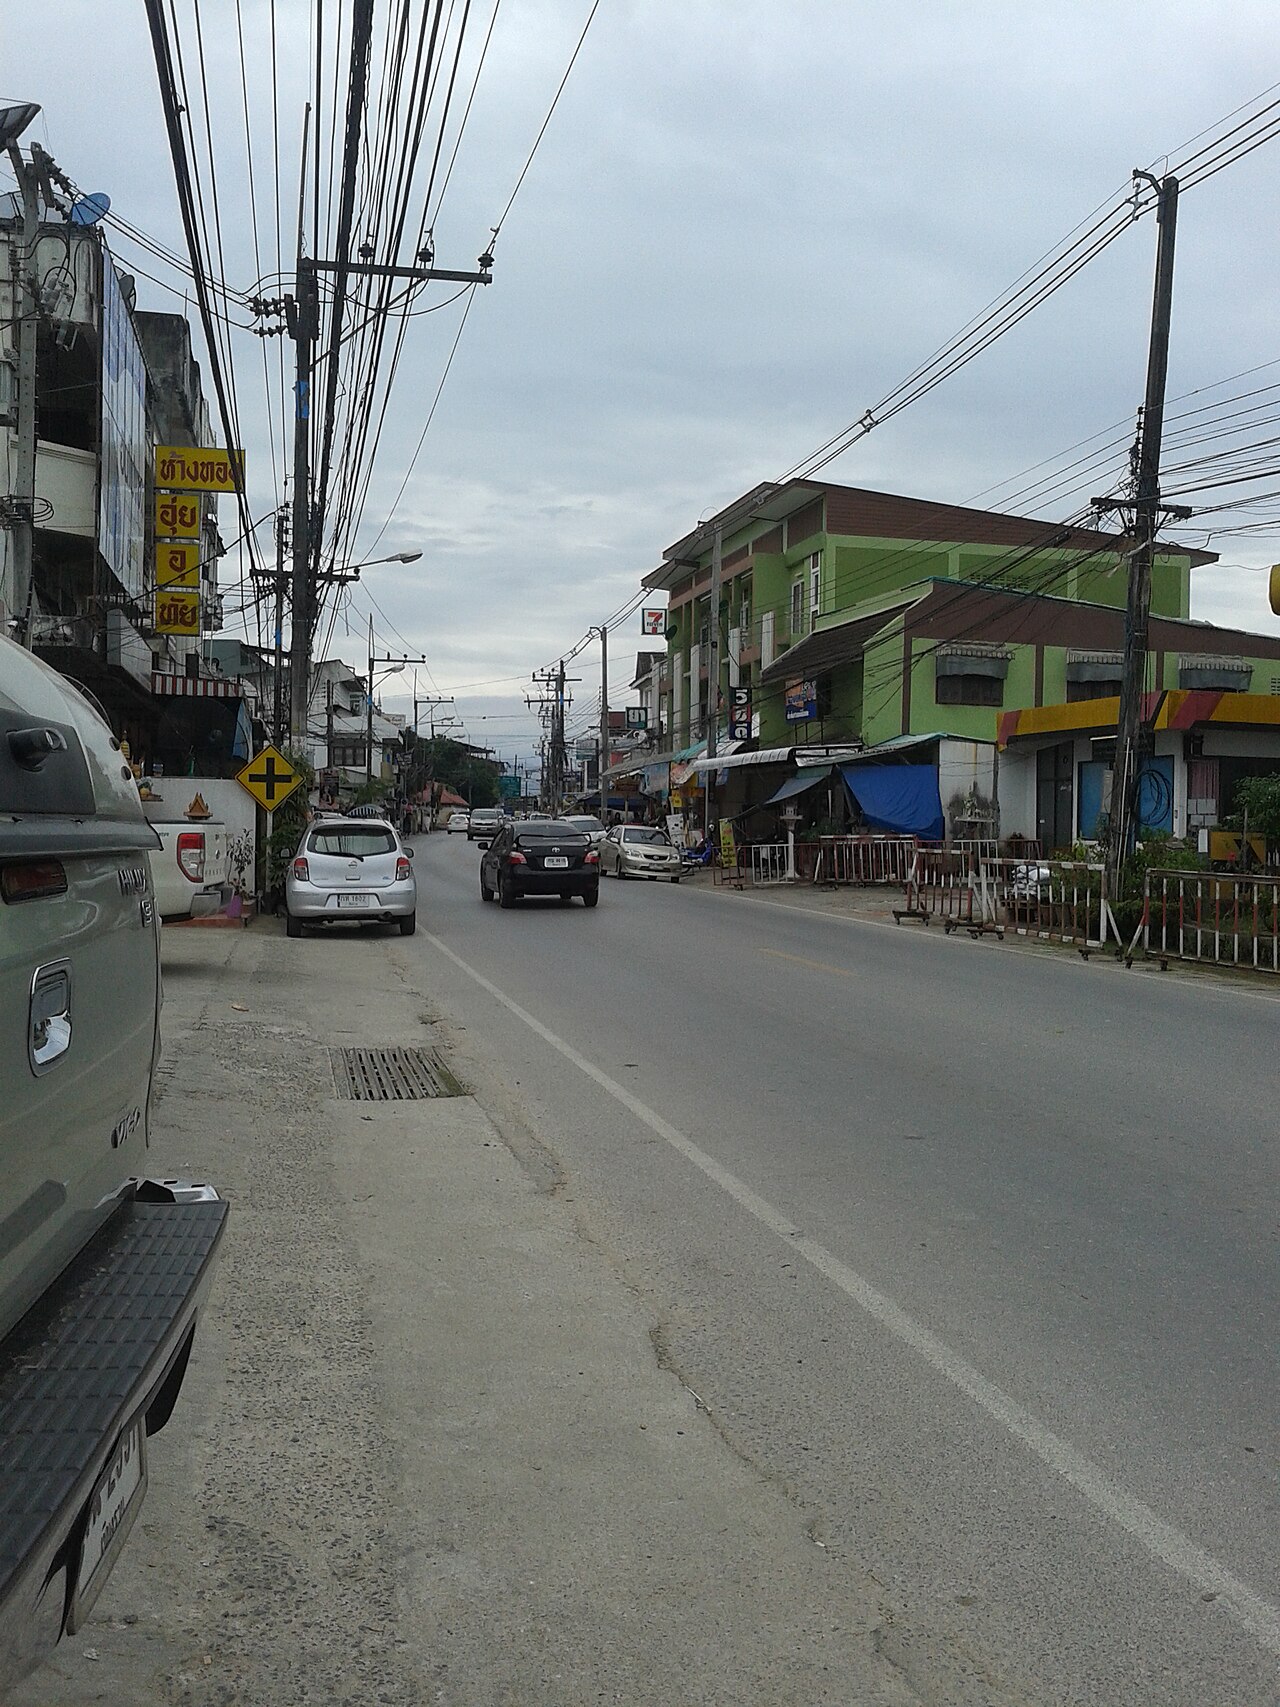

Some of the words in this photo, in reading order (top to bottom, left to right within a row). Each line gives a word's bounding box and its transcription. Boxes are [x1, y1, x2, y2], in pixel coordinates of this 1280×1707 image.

[160, 496, 197, 535] อุ่ย
[168, 550, 187, 582] อุ
[159, 596, 197, 627] ทัย
[647, 611, 664, 634] 7
